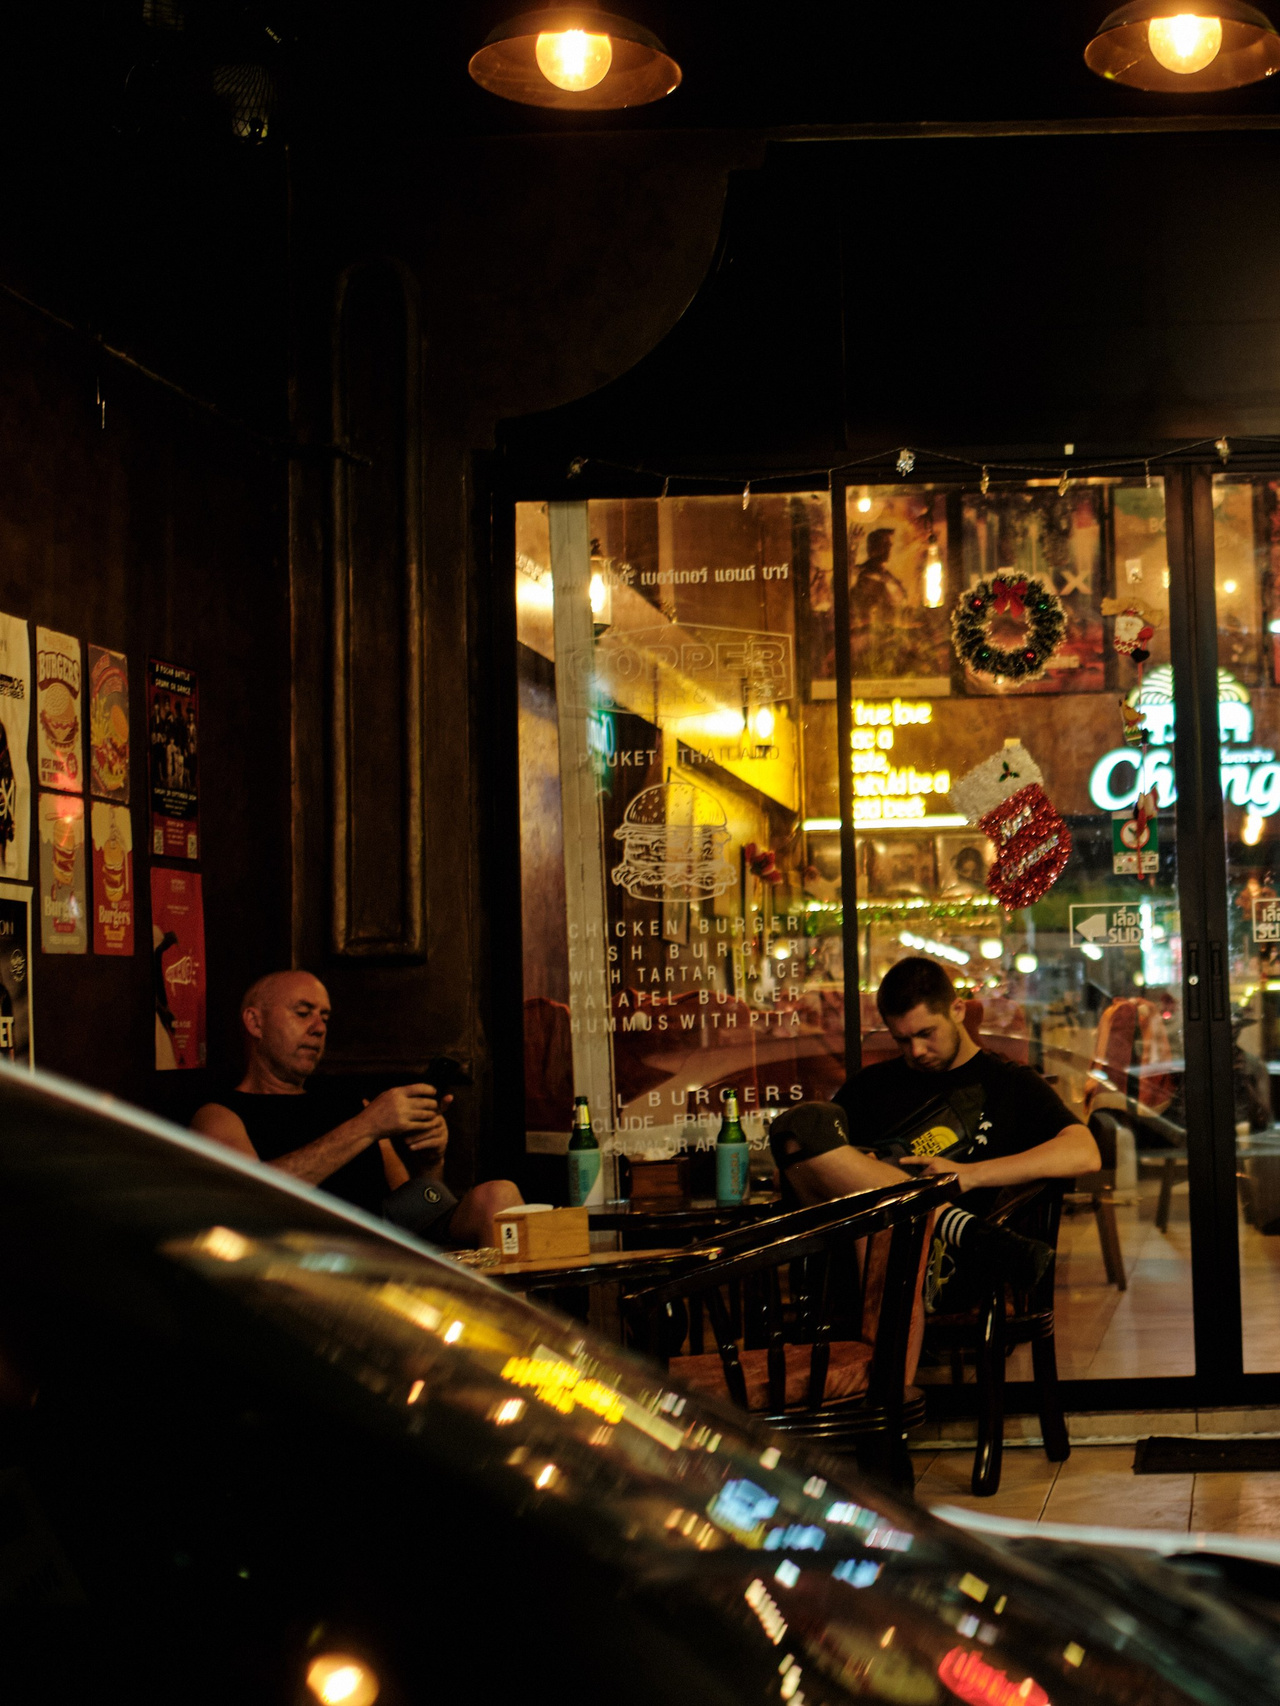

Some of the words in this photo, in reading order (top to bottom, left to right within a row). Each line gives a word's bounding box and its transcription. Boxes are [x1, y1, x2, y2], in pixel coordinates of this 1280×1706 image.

[641, 567, 708, 586] เบอร์เกอร์
[714, 564, 756, 583] แอนด์
[763, 562, 790, 580] บาร์
[38, 650, 80, 694] BURGERS
[568, 643, 787, 682] COPPER
[44, 895, 84, 924] Burgs
[98, 904, 132, 929] Burgers
[569, 919, 679, 939] CHICKEN
[699, 915, 800, 934] BURGER
[1108, 927, 1143, 944] SLID
[569, 944, 643, 964] FISH
[669, 940, 800, 960] BURGER
[570, 968, 622, 986] WITH
[637, 965, 718, 983] TARTAR
[570, 991, 679, 1011] FALAFEL
[699, 987, 801, 1006] BURGER
[571, 1014, 669, 1034] HUMMUS
[680, 1012, 738, 1030] WITH
[750, 1010, 801, 1028] PITA
[574, 1093, 629, 1113] LL
[572, 1115, 654, 1135] ICLUDE
[673, 1108, 749, 1130] FRENH
[910, 1131, 933, 1148] THE
[911, 1138, 937, 1157] RTH
